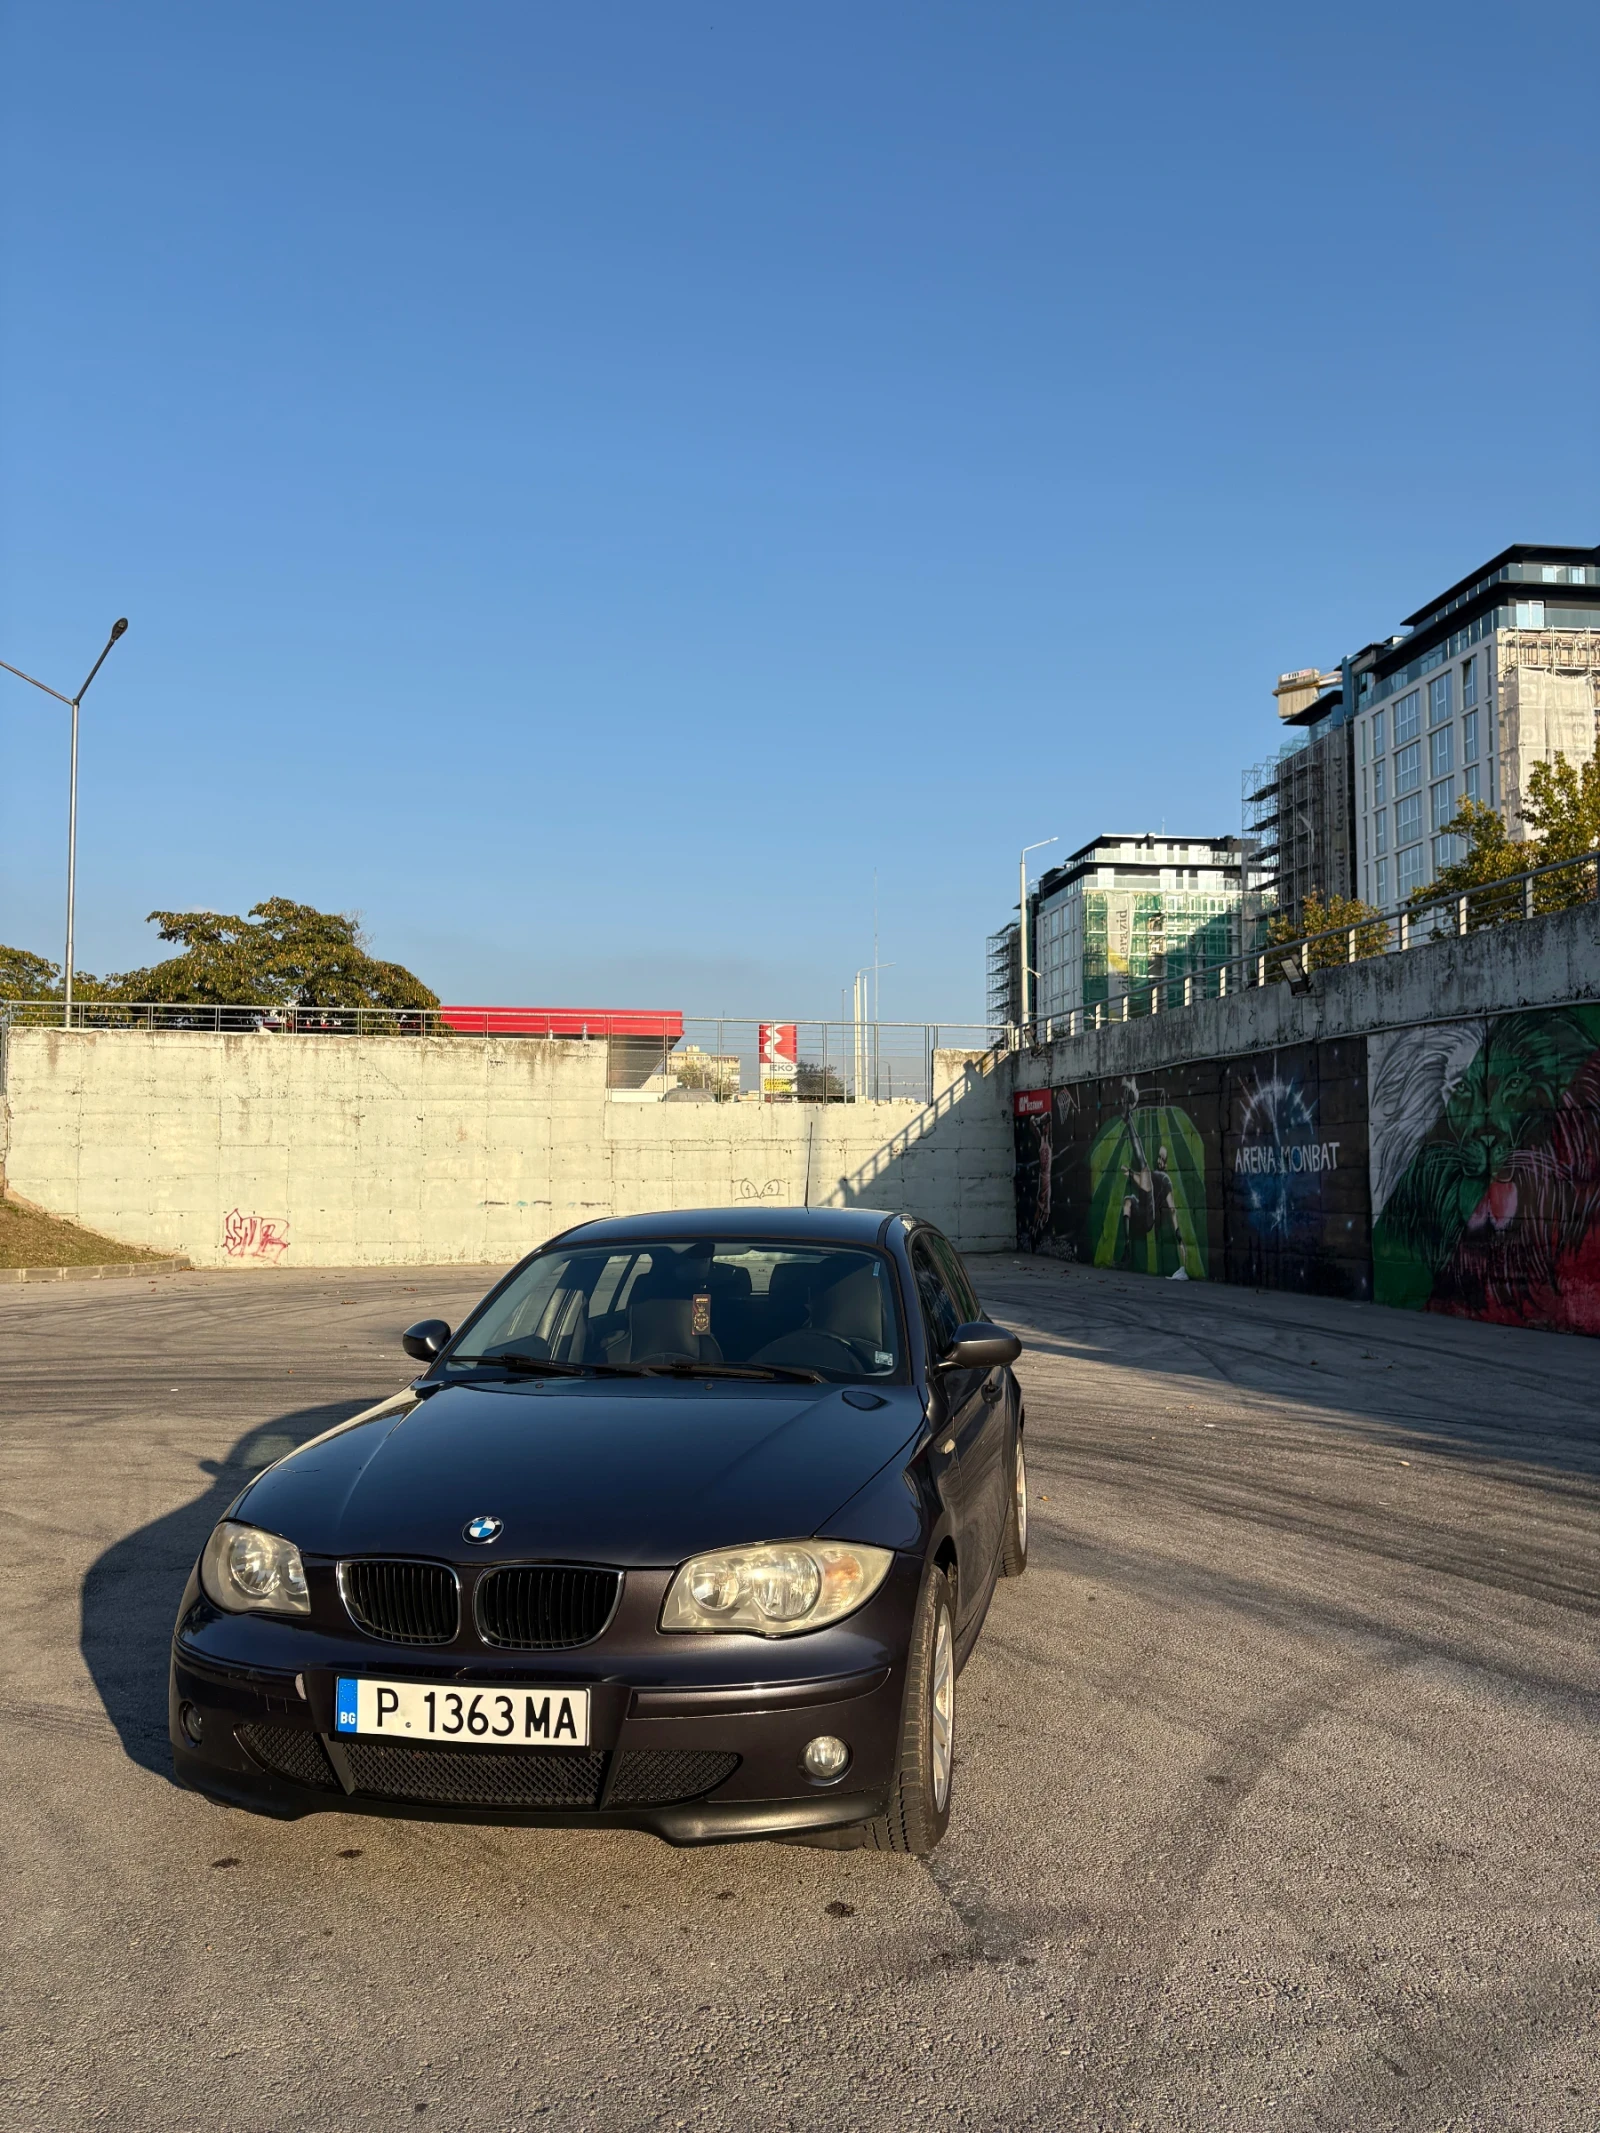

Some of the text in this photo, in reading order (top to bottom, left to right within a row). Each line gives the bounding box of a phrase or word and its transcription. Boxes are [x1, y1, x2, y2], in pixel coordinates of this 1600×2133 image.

[1116, 909, 1129, 961] terazid
[769, 1064, 793, 1072] EKO
[1235, 1145, 1277, 1174] ARENA
[340, 1711, 356, 1725] BG
[424, 1691, 515, 1736] 1363
[524, 1696, 577, 1739] MA
